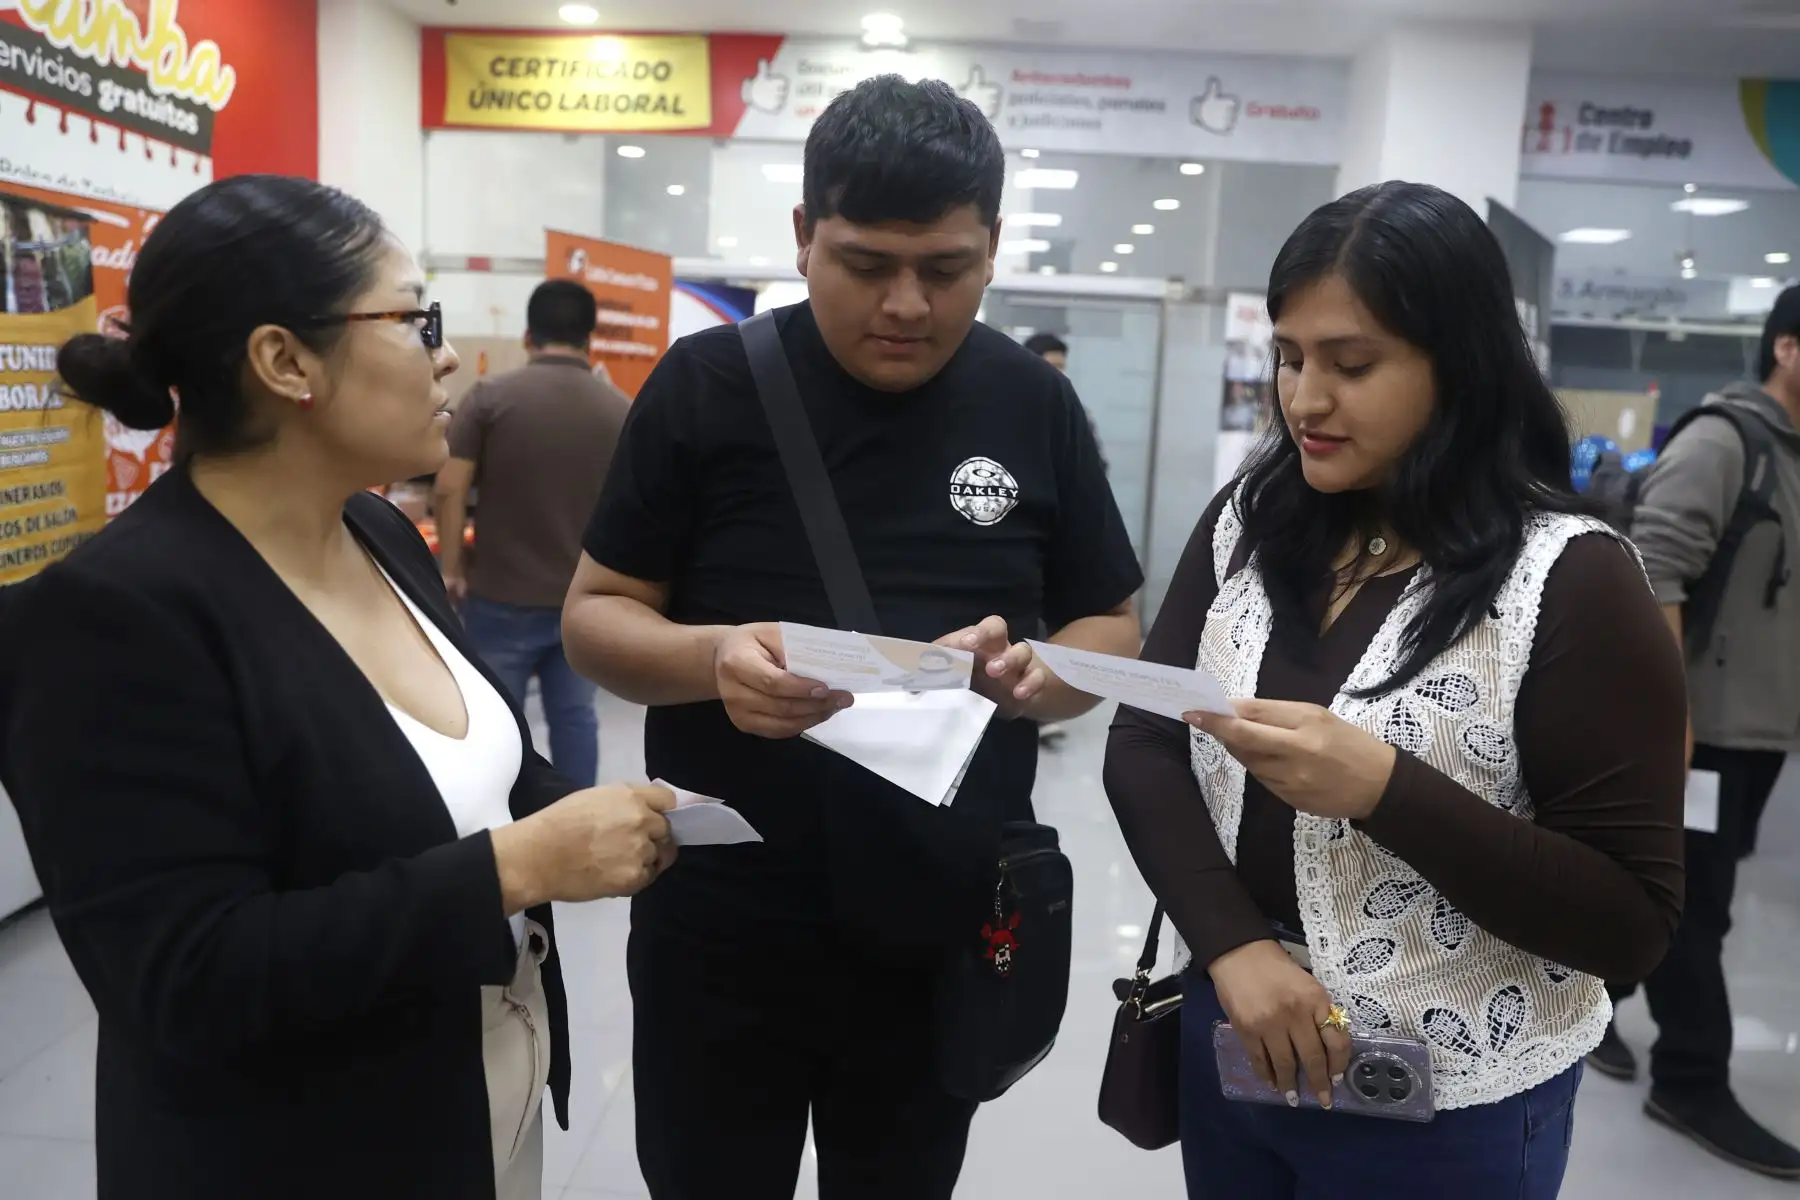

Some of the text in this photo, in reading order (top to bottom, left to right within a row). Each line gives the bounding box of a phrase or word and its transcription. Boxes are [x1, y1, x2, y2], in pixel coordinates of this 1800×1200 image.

[489, 56, 672, 82] CERTIFICADO
[97, 79, 200, 136] gratuitos
[468, 80, 686, 117] ÚNICO LABORAL
[1577, 102, 1655, 129] Centro
[1607, 131, 1694, 160] Empleo
[950, 485, 1019, 498] OAKLEY
